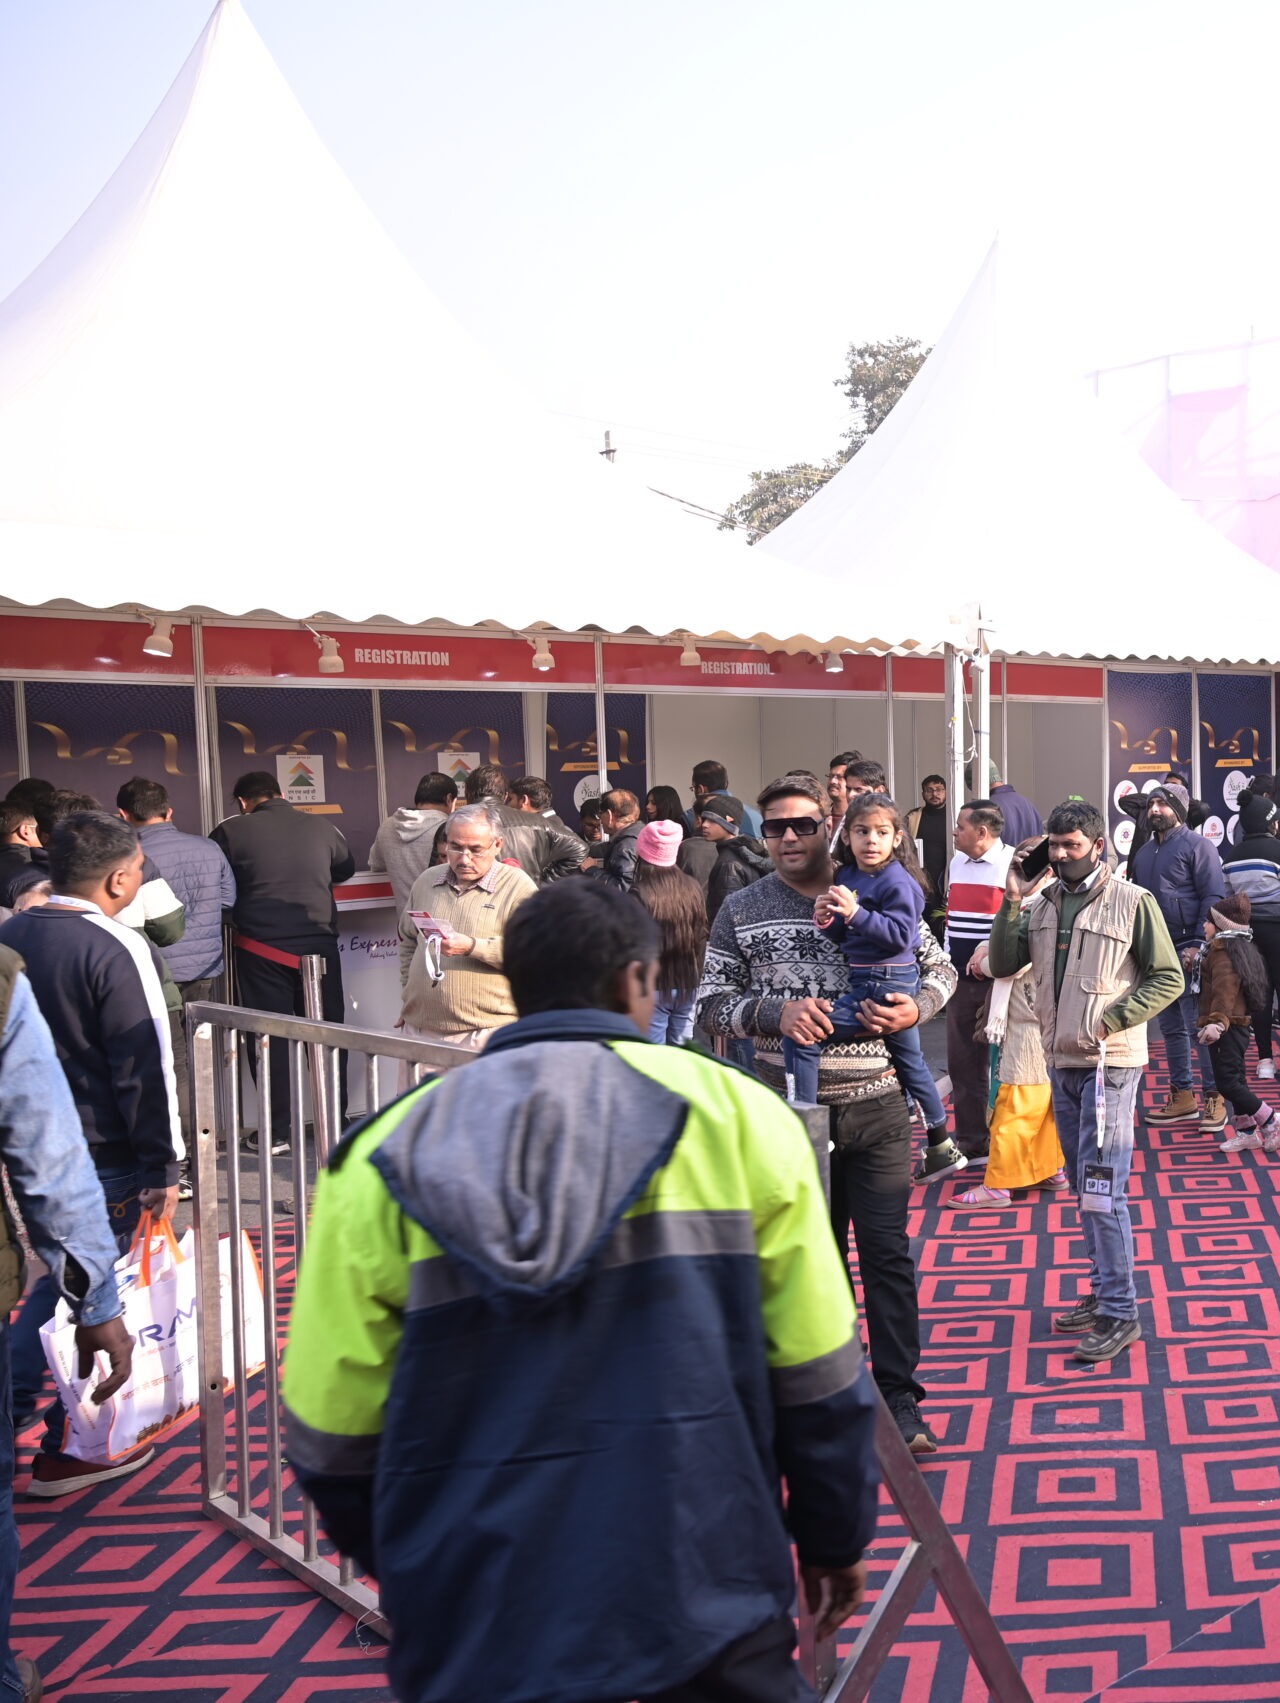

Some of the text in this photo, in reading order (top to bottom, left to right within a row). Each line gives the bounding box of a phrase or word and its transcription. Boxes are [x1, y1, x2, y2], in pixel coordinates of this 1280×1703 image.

[354, 648, 450, 666] REGISTRATION
[701, 661, 771, 675] REGISTRATION
[350, 936, 398, 954] Express
